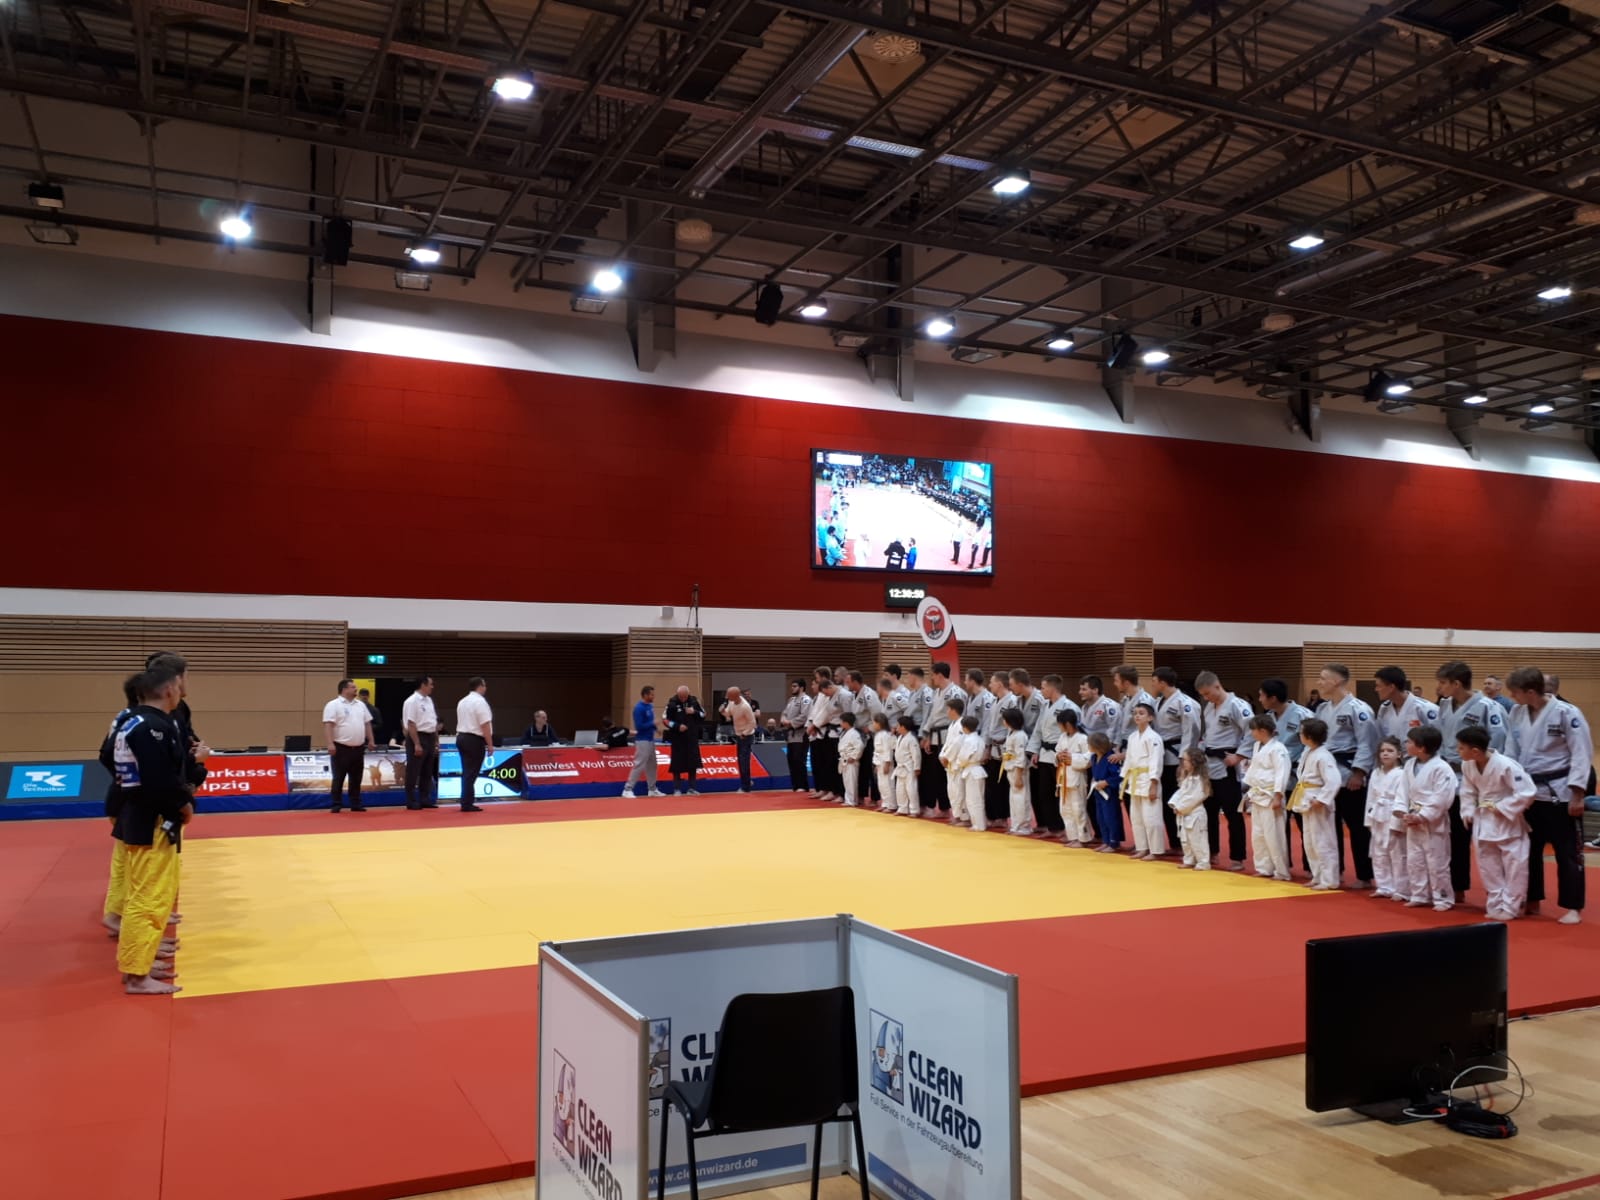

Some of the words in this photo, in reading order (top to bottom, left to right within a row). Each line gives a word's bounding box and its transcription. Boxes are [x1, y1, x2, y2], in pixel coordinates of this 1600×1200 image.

[525, 762, 576, 771] ImmVest
[578, 760, 605, 769] Wolf
[608, 760, 634, 768] Gmb
[696, 765, 738, 775] eipzig
[24, 771, 68, 787] TK
[206, 768, 277, 778] arkasse
[488, 768, 517, 779] 4:00
[202, 780, 250, 792] ipzig
[483, 783, 493, 795] 0
[908, 1050, 964, 1105] CLEAN
[909, 1082, 982, 1150] WIZARD
[578, 1098, 612, 1166] CLEAN
[578, 1134, 623, 1200] WIZARD
